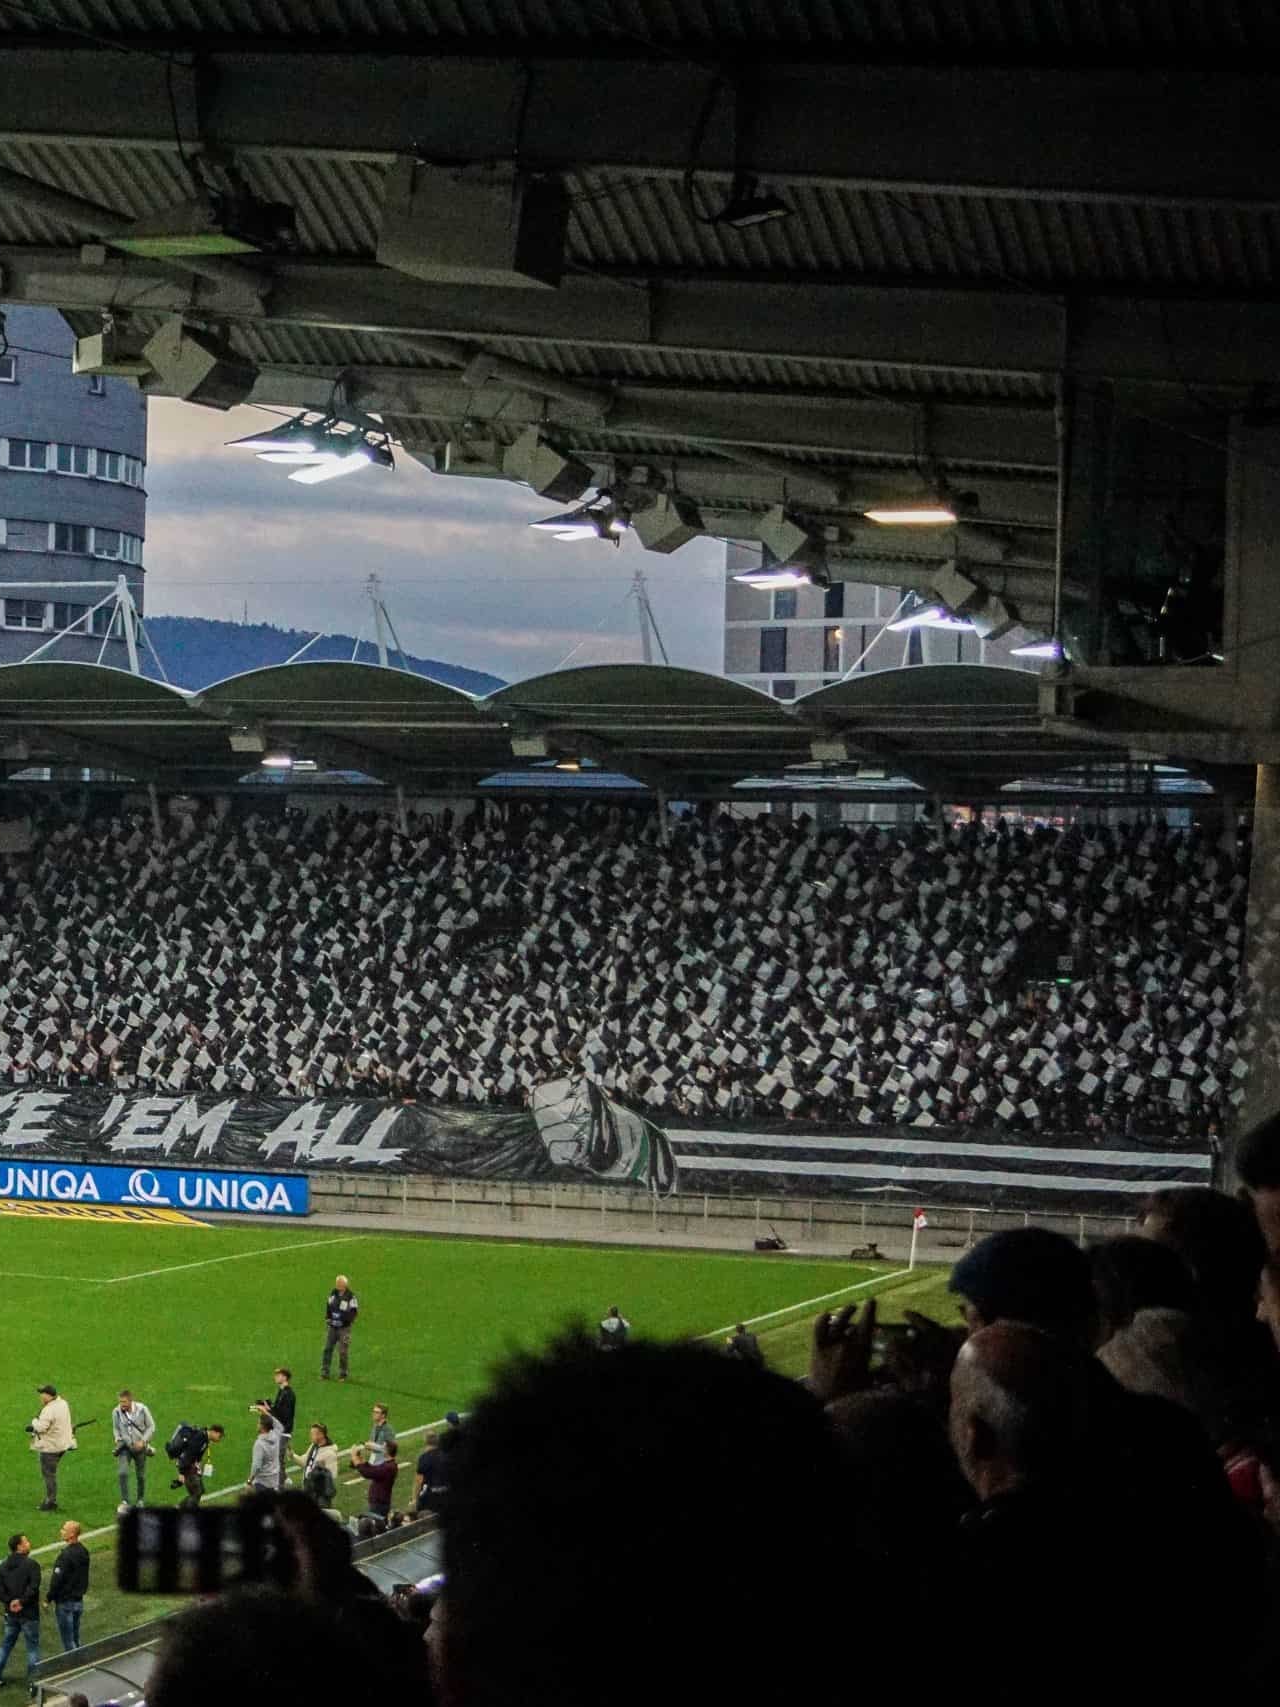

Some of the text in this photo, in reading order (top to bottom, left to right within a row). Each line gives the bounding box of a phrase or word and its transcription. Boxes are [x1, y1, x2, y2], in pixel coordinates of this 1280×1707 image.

[98, 1092, 239, 1158] 'EM
[258, 1098, 412, 1165] ALL
[178, 1176, 294, 1212] UNIQA
